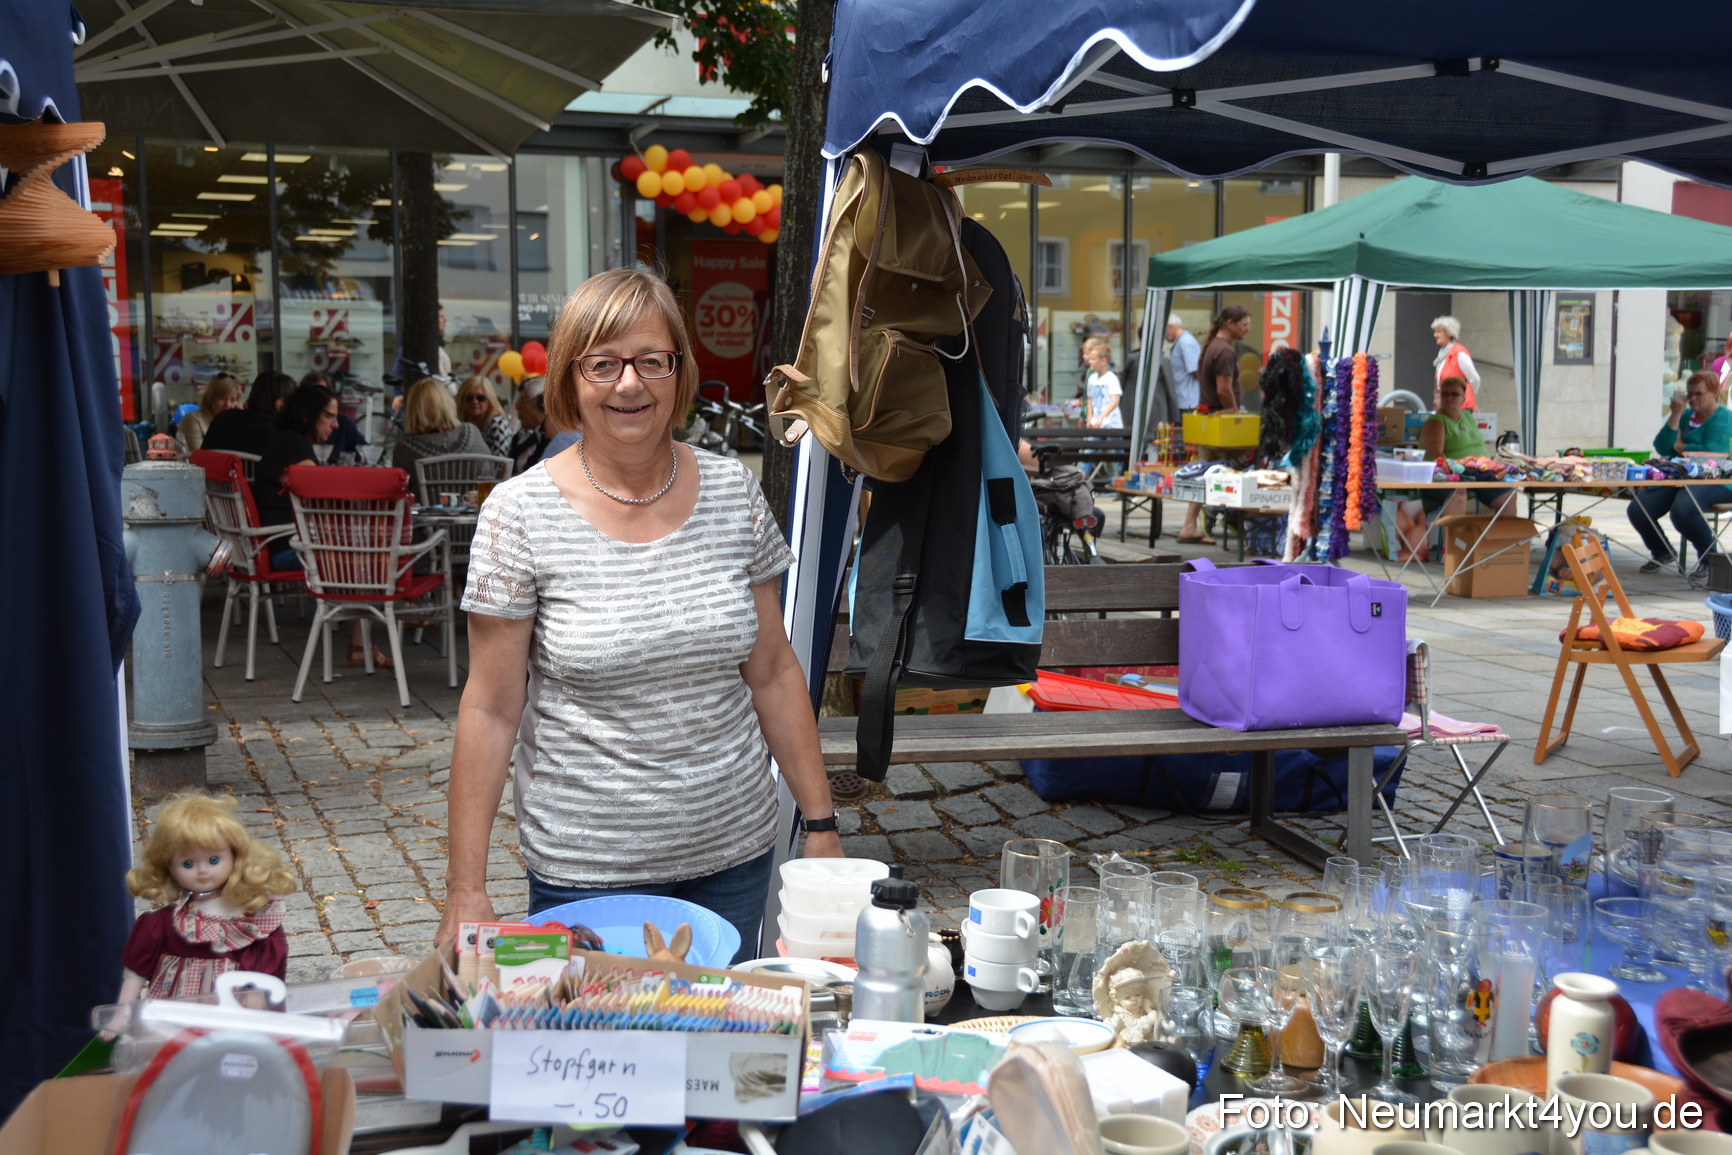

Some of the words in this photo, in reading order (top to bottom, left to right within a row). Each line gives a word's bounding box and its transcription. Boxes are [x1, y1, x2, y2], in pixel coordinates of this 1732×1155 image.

[1019, 173, 1032, 181] Ulm
[694, 256, 736, 271] Happy
[740, 256, 767, 269] Sale
[518, 304, 548, 313] MO-FR
[518, 313, 531, 321] SA
[699, 304, 755, 328] 30%
[1249, 493, 1281, 503] SPINACI
[527, 1045, 637, 1082] Stopfgarn
[686, 1079, 719, 1091] MAES
